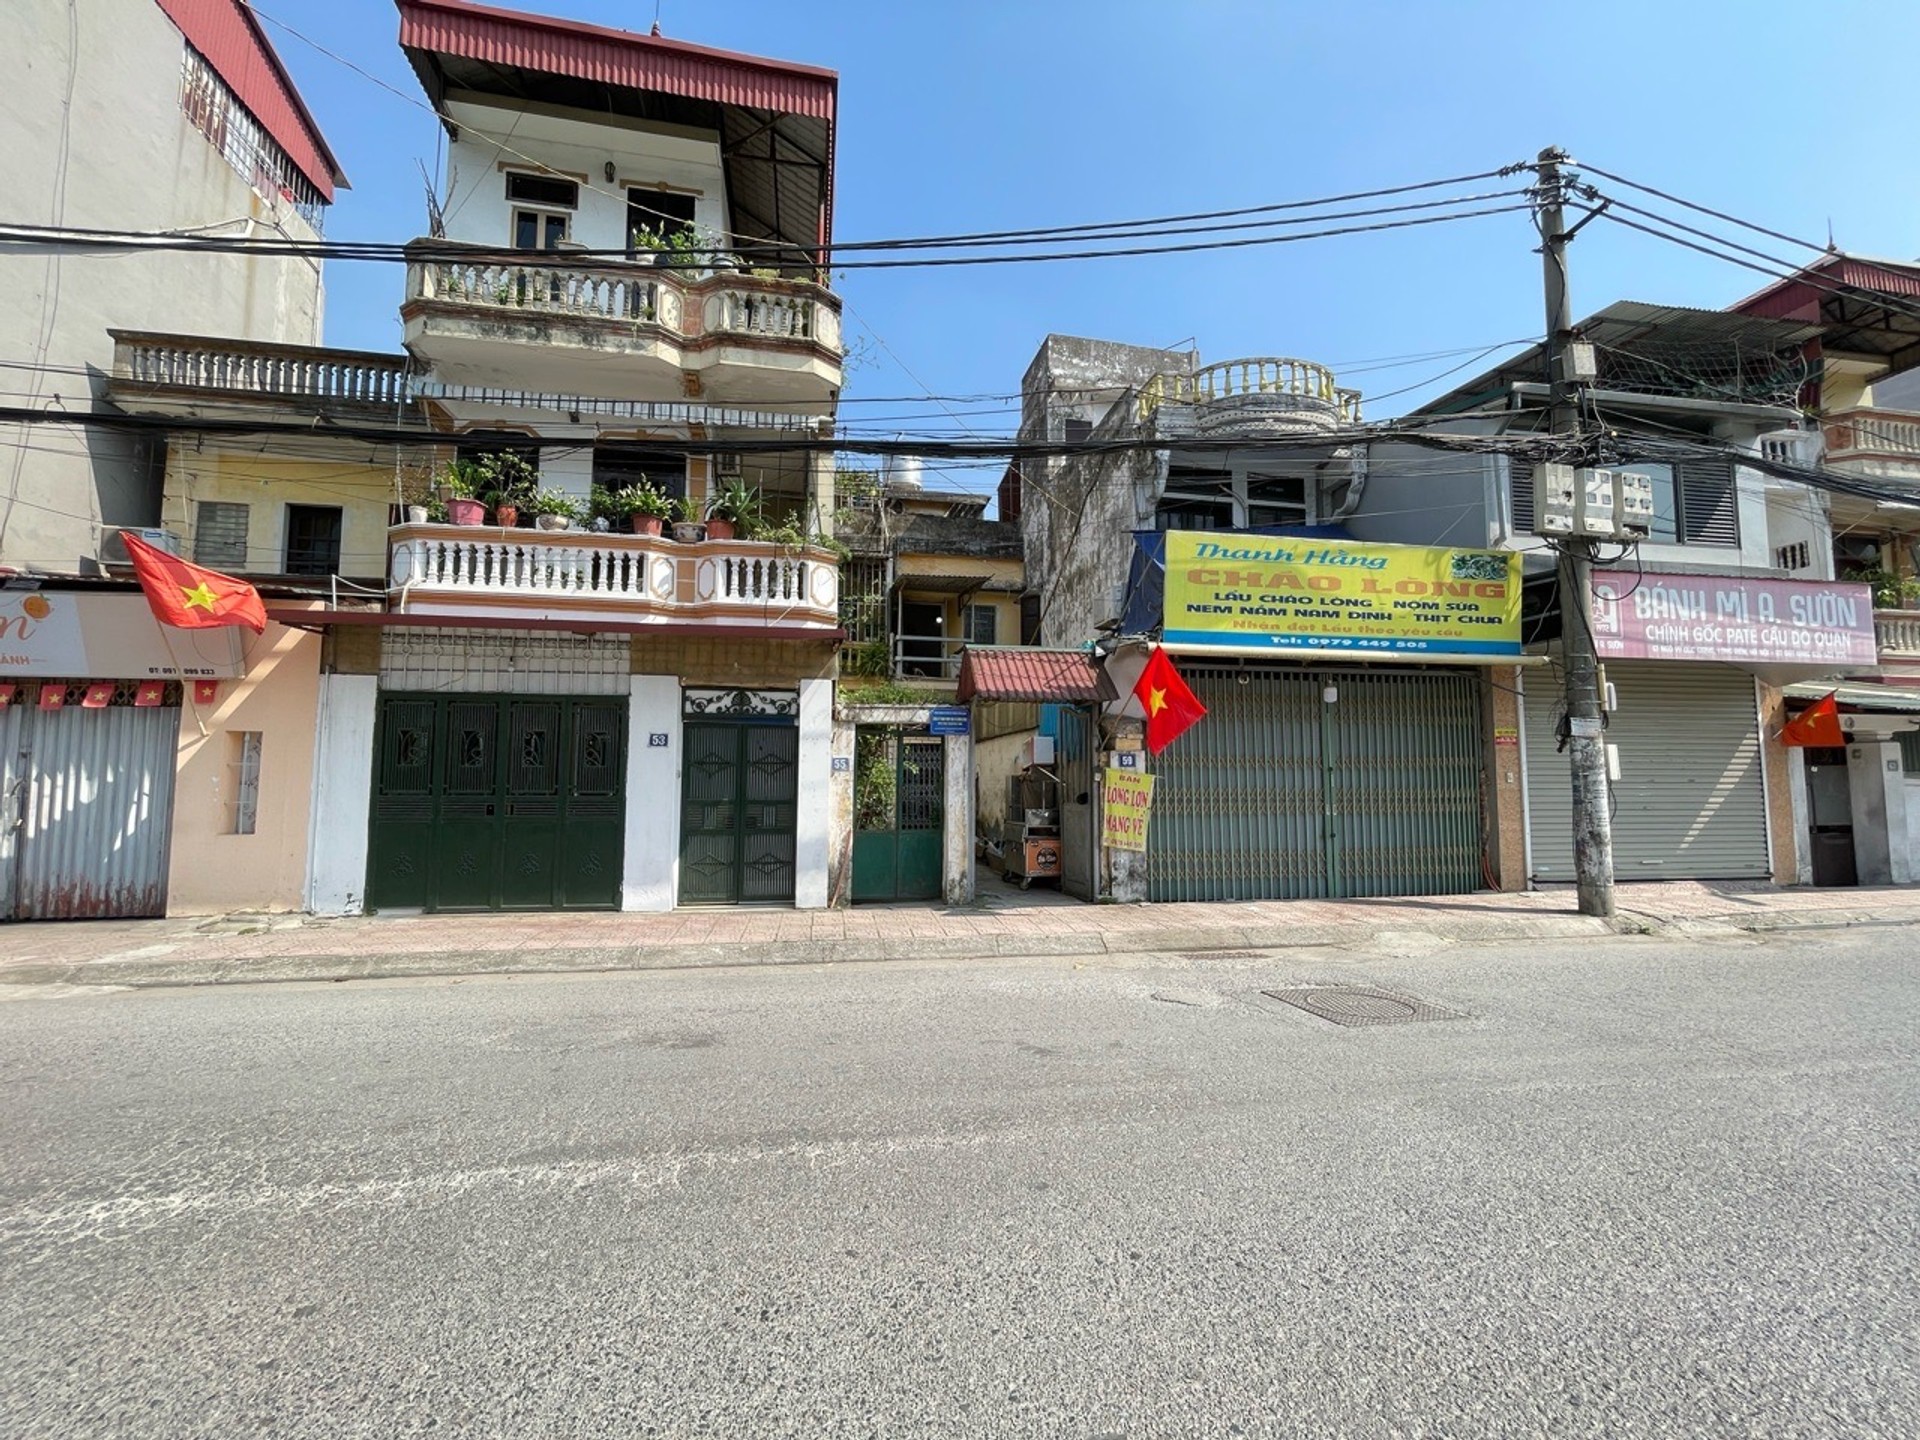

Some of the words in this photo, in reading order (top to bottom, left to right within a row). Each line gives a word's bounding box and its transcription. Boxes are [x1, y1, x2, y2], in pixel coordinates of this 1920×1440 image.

[1196, 543, 1296, 562] Thanh
[1304, 549, 1389, 570] Hằng
[1187, 569, 1342, 591] CHÁO
[1361, 576, 1506, 599] LÒNG
[1259, 593, 1313, 605] CHÁO
[1320, 596, 1373, 608] LÒNG
[1634, 581, 1707, 621] BÁNH
[1715, 586, 1749, 623] MÌ
[1758, 592, 1781, 624] A.
[1789, 590, 1857, 628] SƯỜN
[1186, 604, 1233, 615] NEM
[1294, 609, 1340, 619] NAM
[1347, 611, 1393, 622] ĐỊNH
[1413, 613, 1452, 624] THỊT
[1358, 625, 1395, 634] theo
[1645, 623, 1689, 643] CHÍNH
[1692, 622, 1723, 643] GỐC
[1270, 635, 1302, 645] Tel:
[1308, 637, 1353, 646] 0979
[1358, 639, 1391, 648] 449
[652, 735, 666, 745] 53
[833, 759, 846, 769] 55
[1122, 755, 1134, 766] 59
